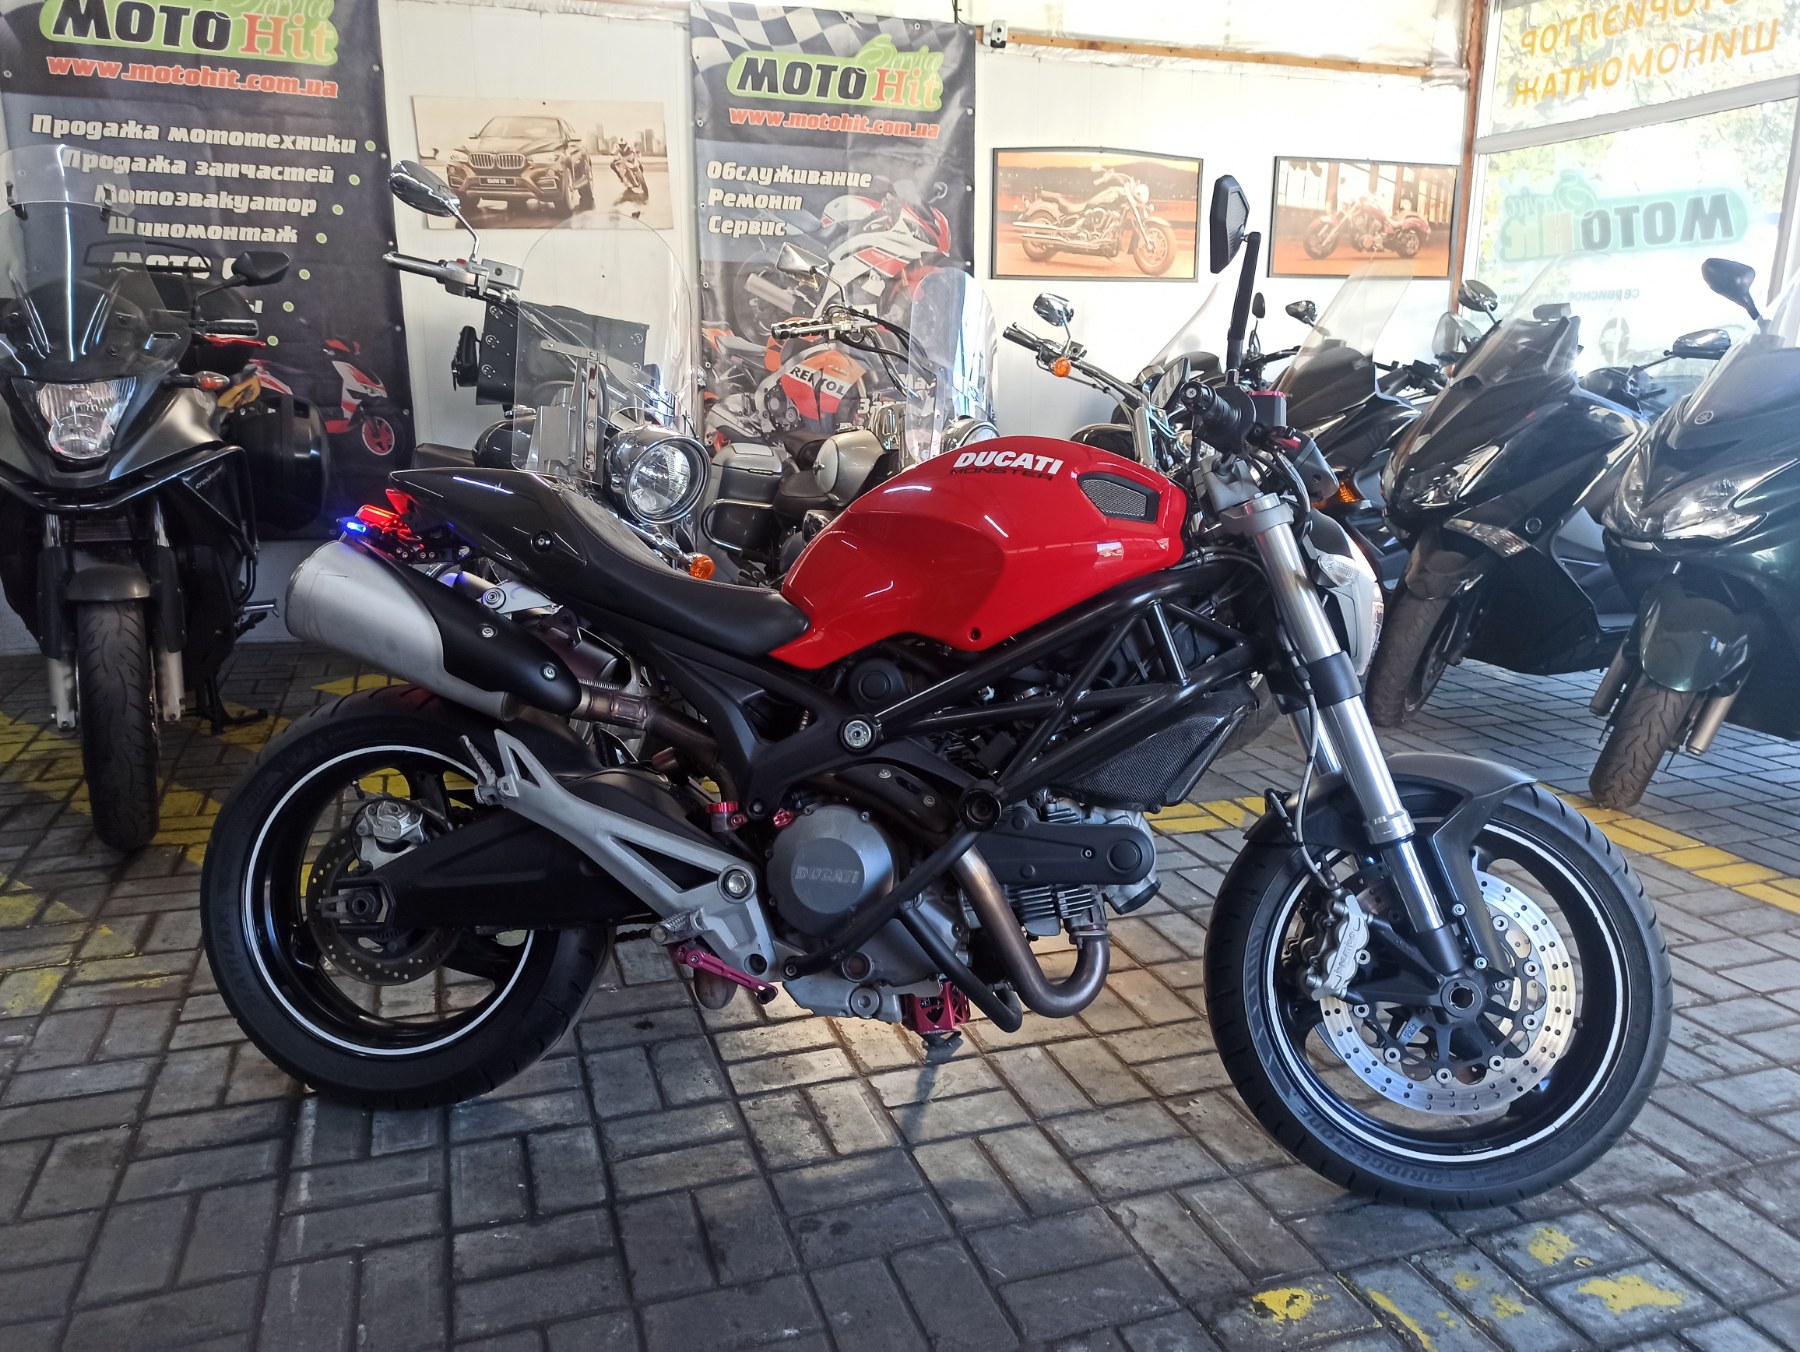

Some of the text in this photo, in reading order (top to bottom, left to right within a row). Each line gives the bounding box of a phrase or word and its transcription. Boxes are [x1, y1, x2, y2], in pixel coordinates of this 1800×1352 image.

[51, 0, 335, 62] MOTO Hit
[46, 56, 339, 98] www.motohit.com.ua
[736, 56, 941, 109] MOTO Hit
[31, 113, 357, 154] Продажа мототехники
[729, 107, 941, 139] www.motohit.com.ua
[62, 148, 335, 184] Продажа запчастей
[706, 160, 872, 189] Обслуживание
[707, 187, 803, 211] Ремонт
[107, 215, 299, 243] Шиномонтаж
[707, 215, 788, 238] Сервис
[950, 467, 1055, 482] MONSTER
[953, 450, 1064, 475] DUCATI
[794, 865, 860, 884] DUCATI
